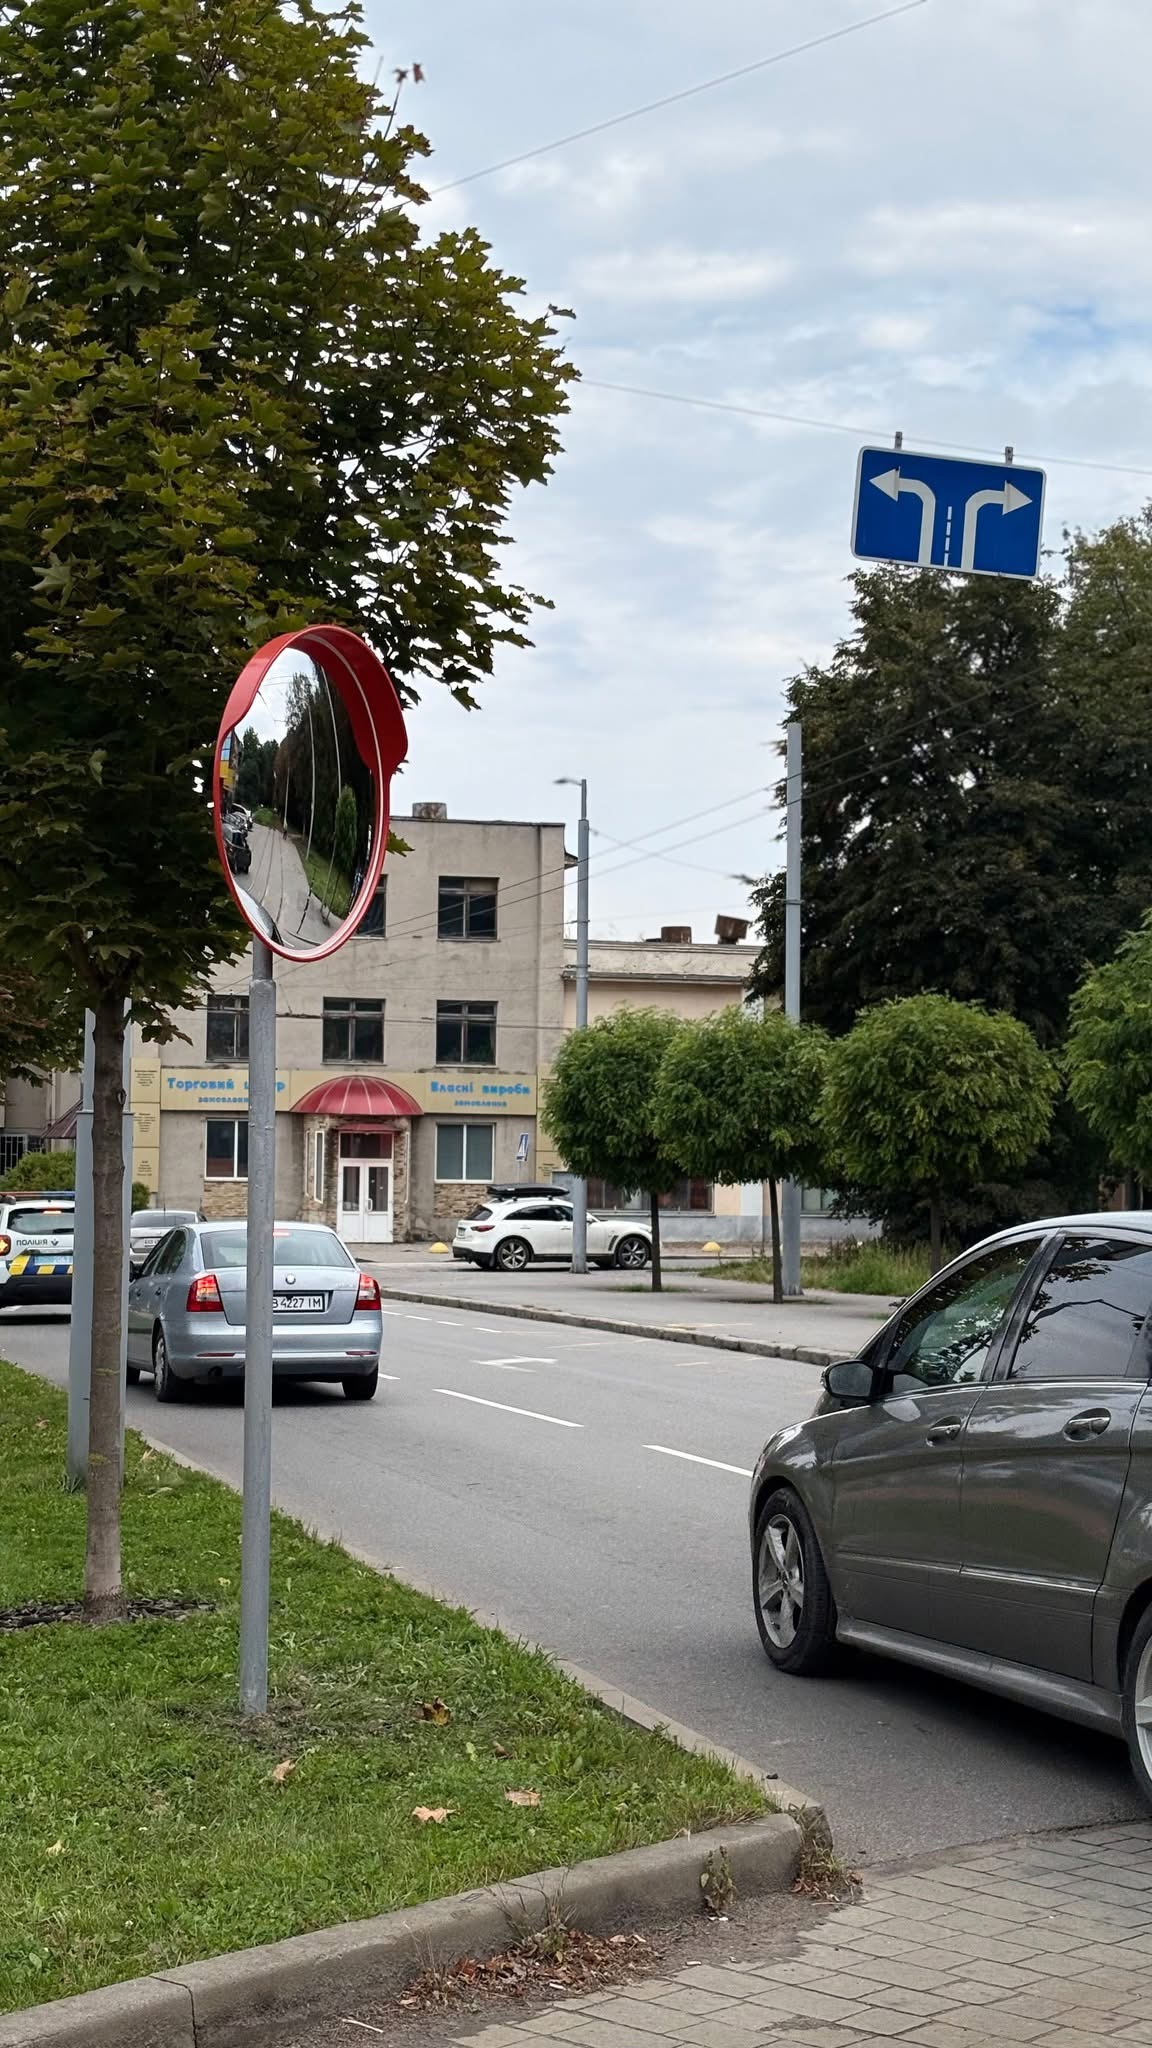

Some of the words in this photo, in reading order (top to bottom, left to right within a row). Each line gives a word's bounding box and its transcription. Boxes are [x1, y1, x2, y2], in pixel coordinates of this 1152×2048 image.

[167, 1077, 234, 1091] Торговий
[430, 1081, 473, 1093] Власні
[482, 1083, 530, 1095] вироби
[281, 1298, 304, 1308] 4227
[308, 1297, 321, 1308] IM
